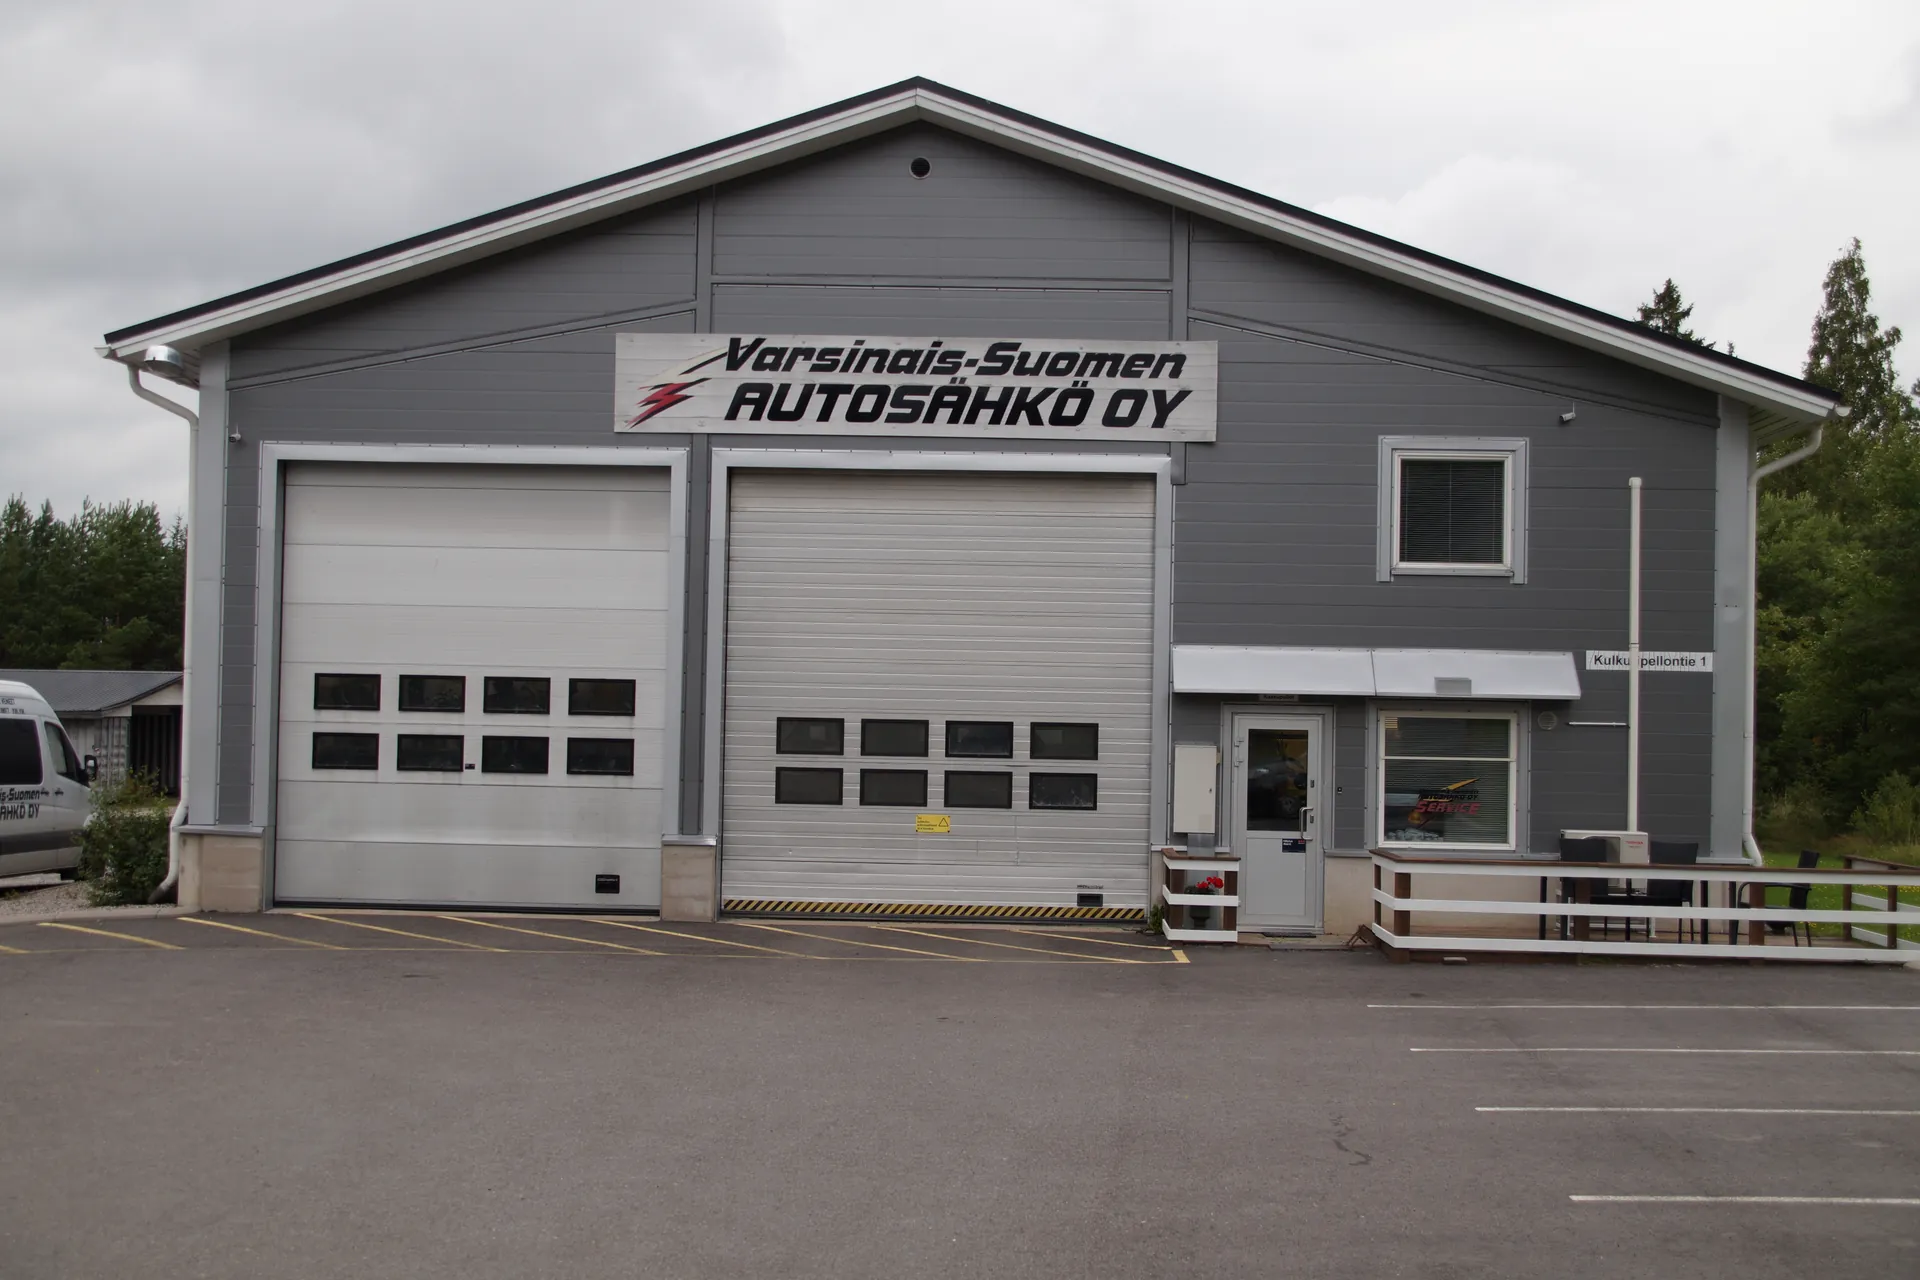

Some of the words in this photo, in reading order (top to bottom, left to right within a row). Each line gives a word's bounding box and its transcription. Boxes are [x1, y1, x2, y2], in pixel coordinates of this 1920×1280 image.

[726, 337, 1187, 379] Varsinais-Suomen
[724, 377, 1095, 427] AUTOSÄHKÖ
[1101, 388, 1193, 428] OY
[1594, 654, 1696, 668] Kulkuipellontie
[1700, 657, 1706, 667] 1
[28, 804, 40, 819] OY
[1415, 801, 1480, 814] SERVICE
